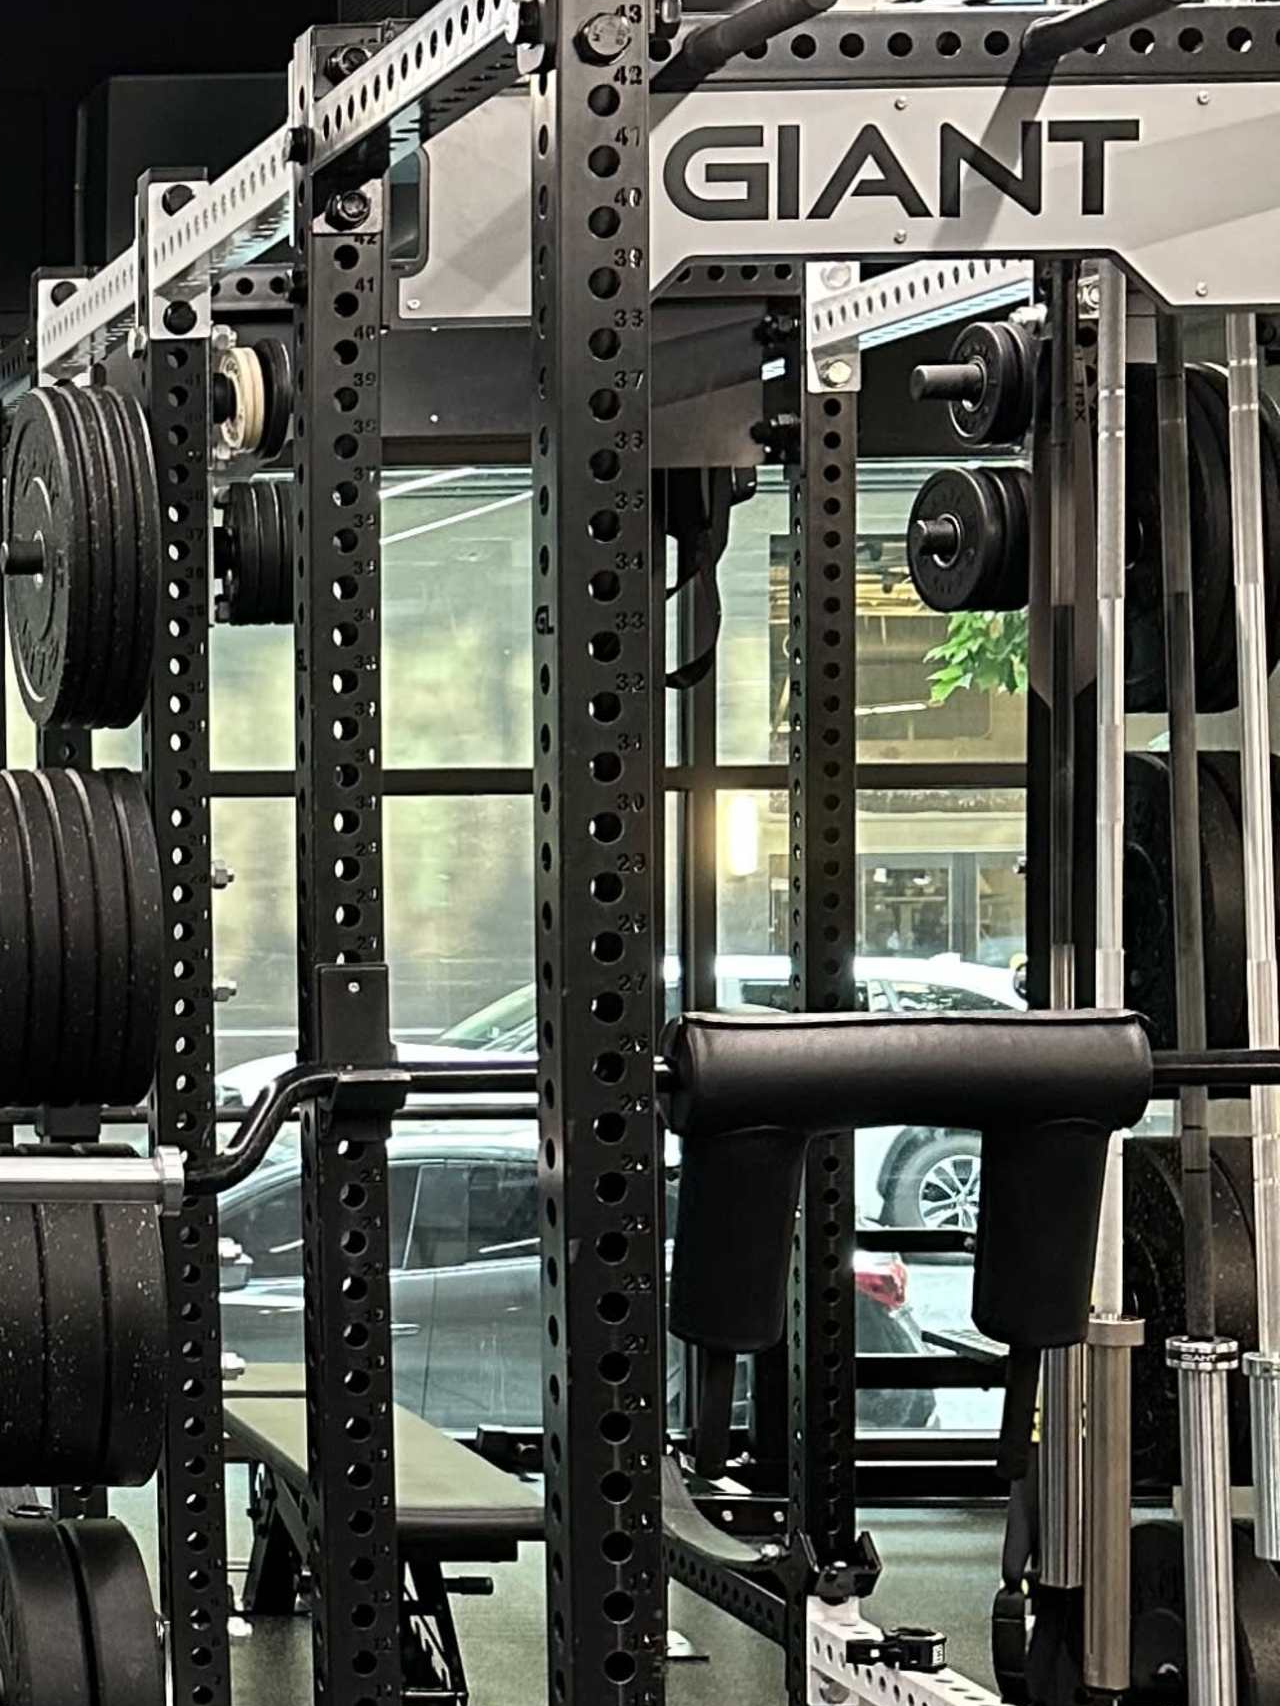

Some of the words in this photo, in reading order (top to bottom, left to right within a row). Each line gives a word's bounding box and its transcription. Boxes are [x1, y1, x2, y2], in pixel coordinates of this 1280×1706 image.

[615, 4, 642, 24] 43
[613, 65, 642, 85] 42
[613, 126, 642, 145] 41
[663, 120, 1140, 221] GIANT
[614, 186, 642, 206] 40
[614, 247, 643, 267] 39
[354, 277, 375, 293] 41
[354, 325, 376, 340] 40
[354, 372, 376, 387] 39
[615, 368, 643, 387] 37
[616, 550, 644, 569] 34
[616, 611, 644, 629] 33
[617, 793, 645, 811] 30
